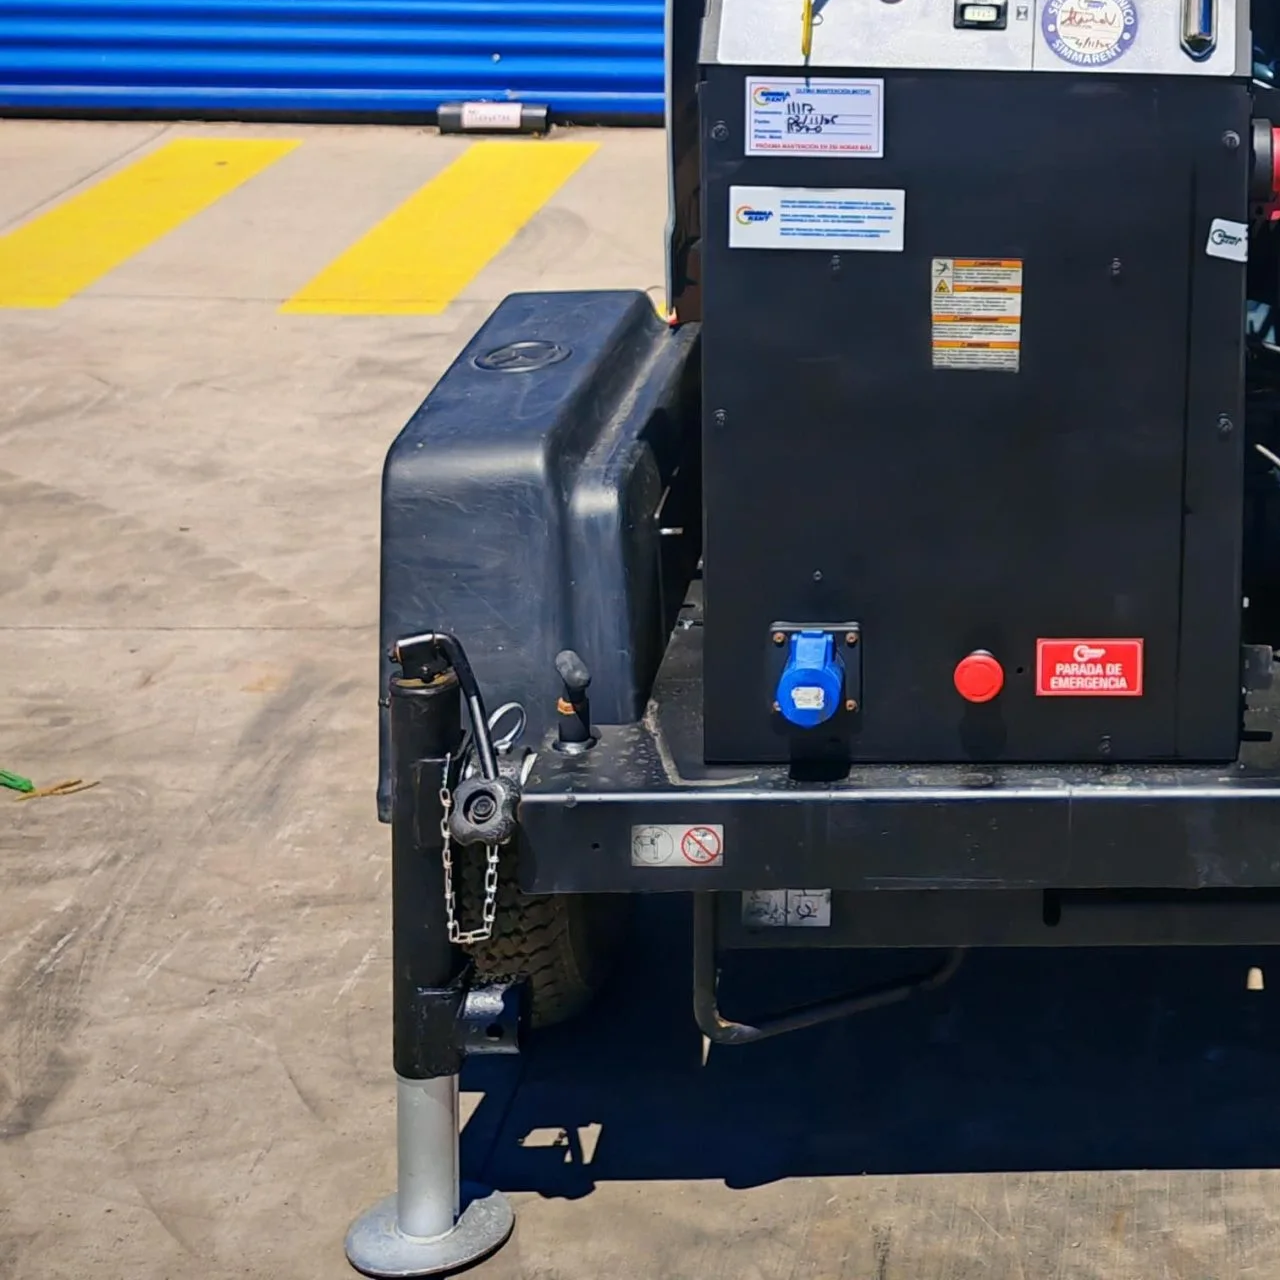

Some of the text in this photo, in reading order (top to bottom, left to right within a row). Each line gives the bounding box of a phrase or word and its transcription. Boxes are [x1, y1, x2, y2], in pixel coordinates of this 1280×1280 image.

[1052, 39, 1122, 64] SIMMARENT
[1056, 663, 1123, 676] PARADA DE
[1050, 677, 1128, 689] EMERGENCIA
